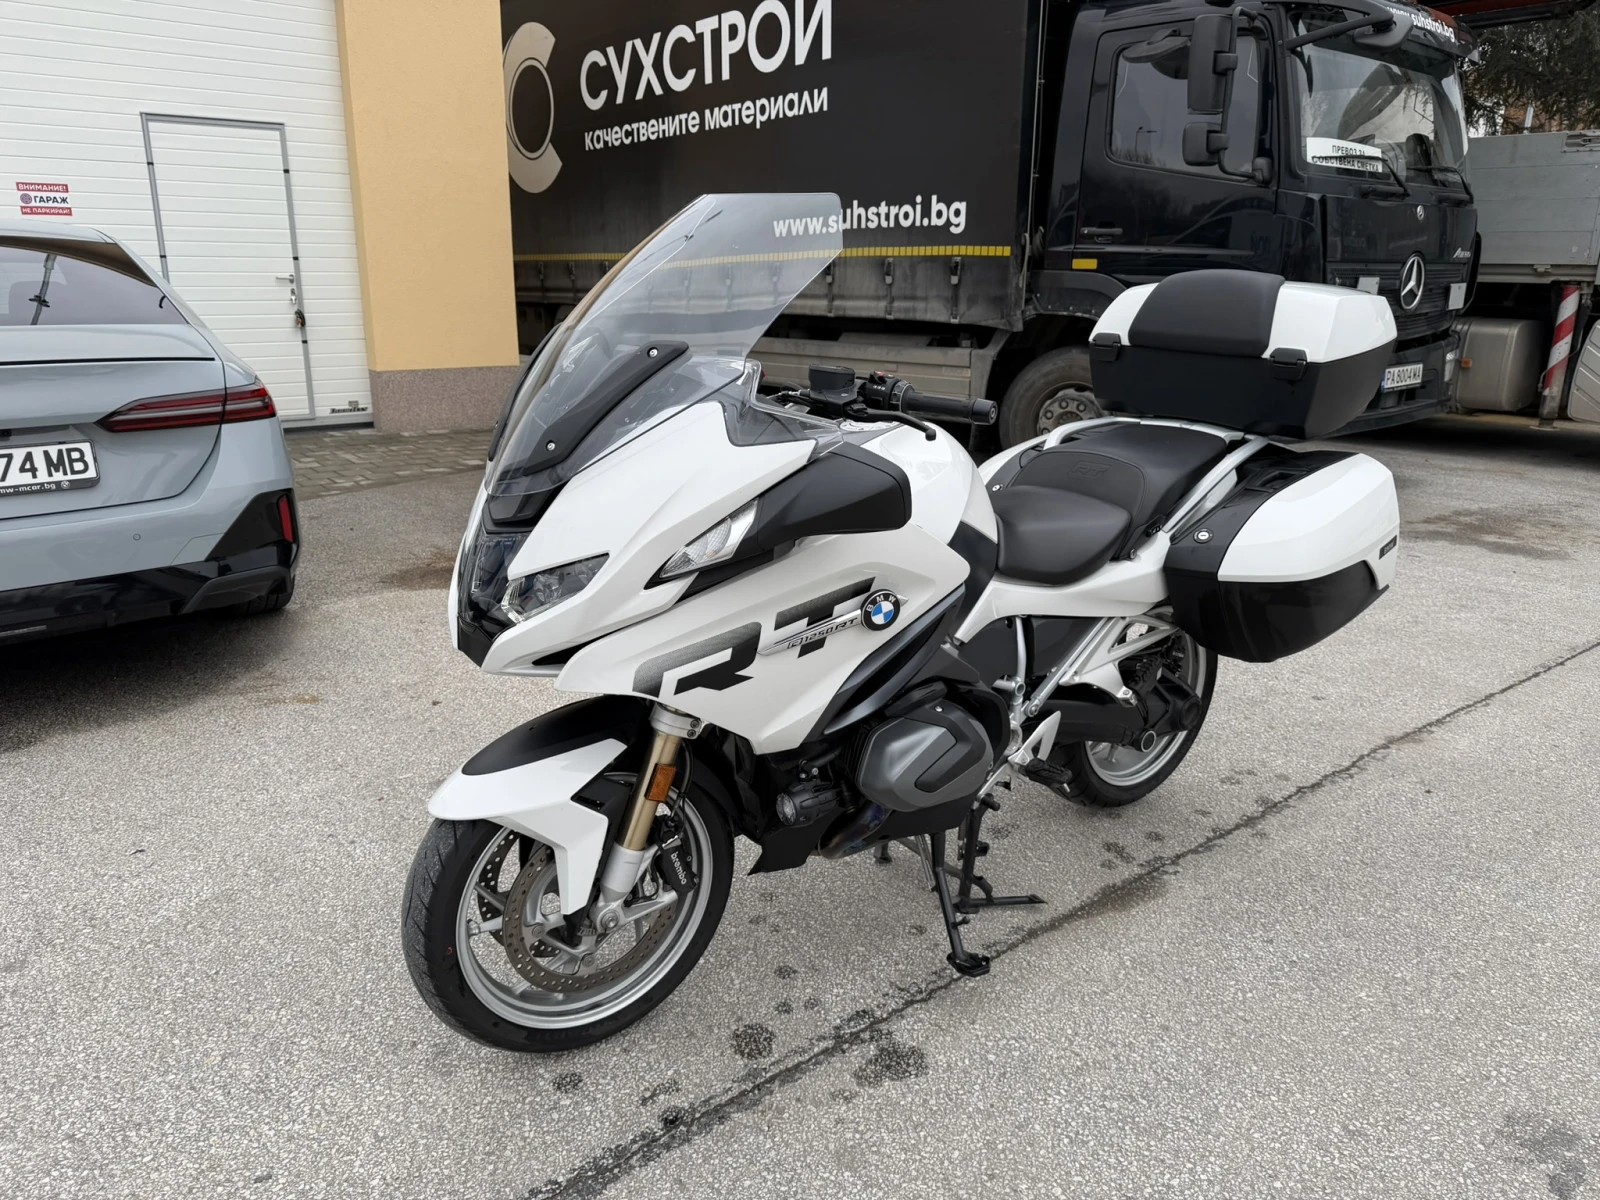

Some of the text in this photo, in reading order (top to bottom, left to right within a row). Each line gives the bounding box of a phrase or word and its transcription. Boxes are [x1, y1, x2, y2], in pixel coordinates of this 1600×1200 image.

[584, 86, 828, 151] качествените материали
[1332, 144, 1357, 155] ПРЕВОЗ
[1356, 159, 1379, 172] СМЕТКА
[18, 183, 67, 192] ВНИМАНИЕ!
[33, 195, 69, 205] ГАРАЖ
[32, 207, 70, 215] ПАРКИРАЙ!
[772, 194, 967, 238] www.suhstroi.bg
[865, 594, 897, 613] BMW
[670, 850, 687, 886] brembo
